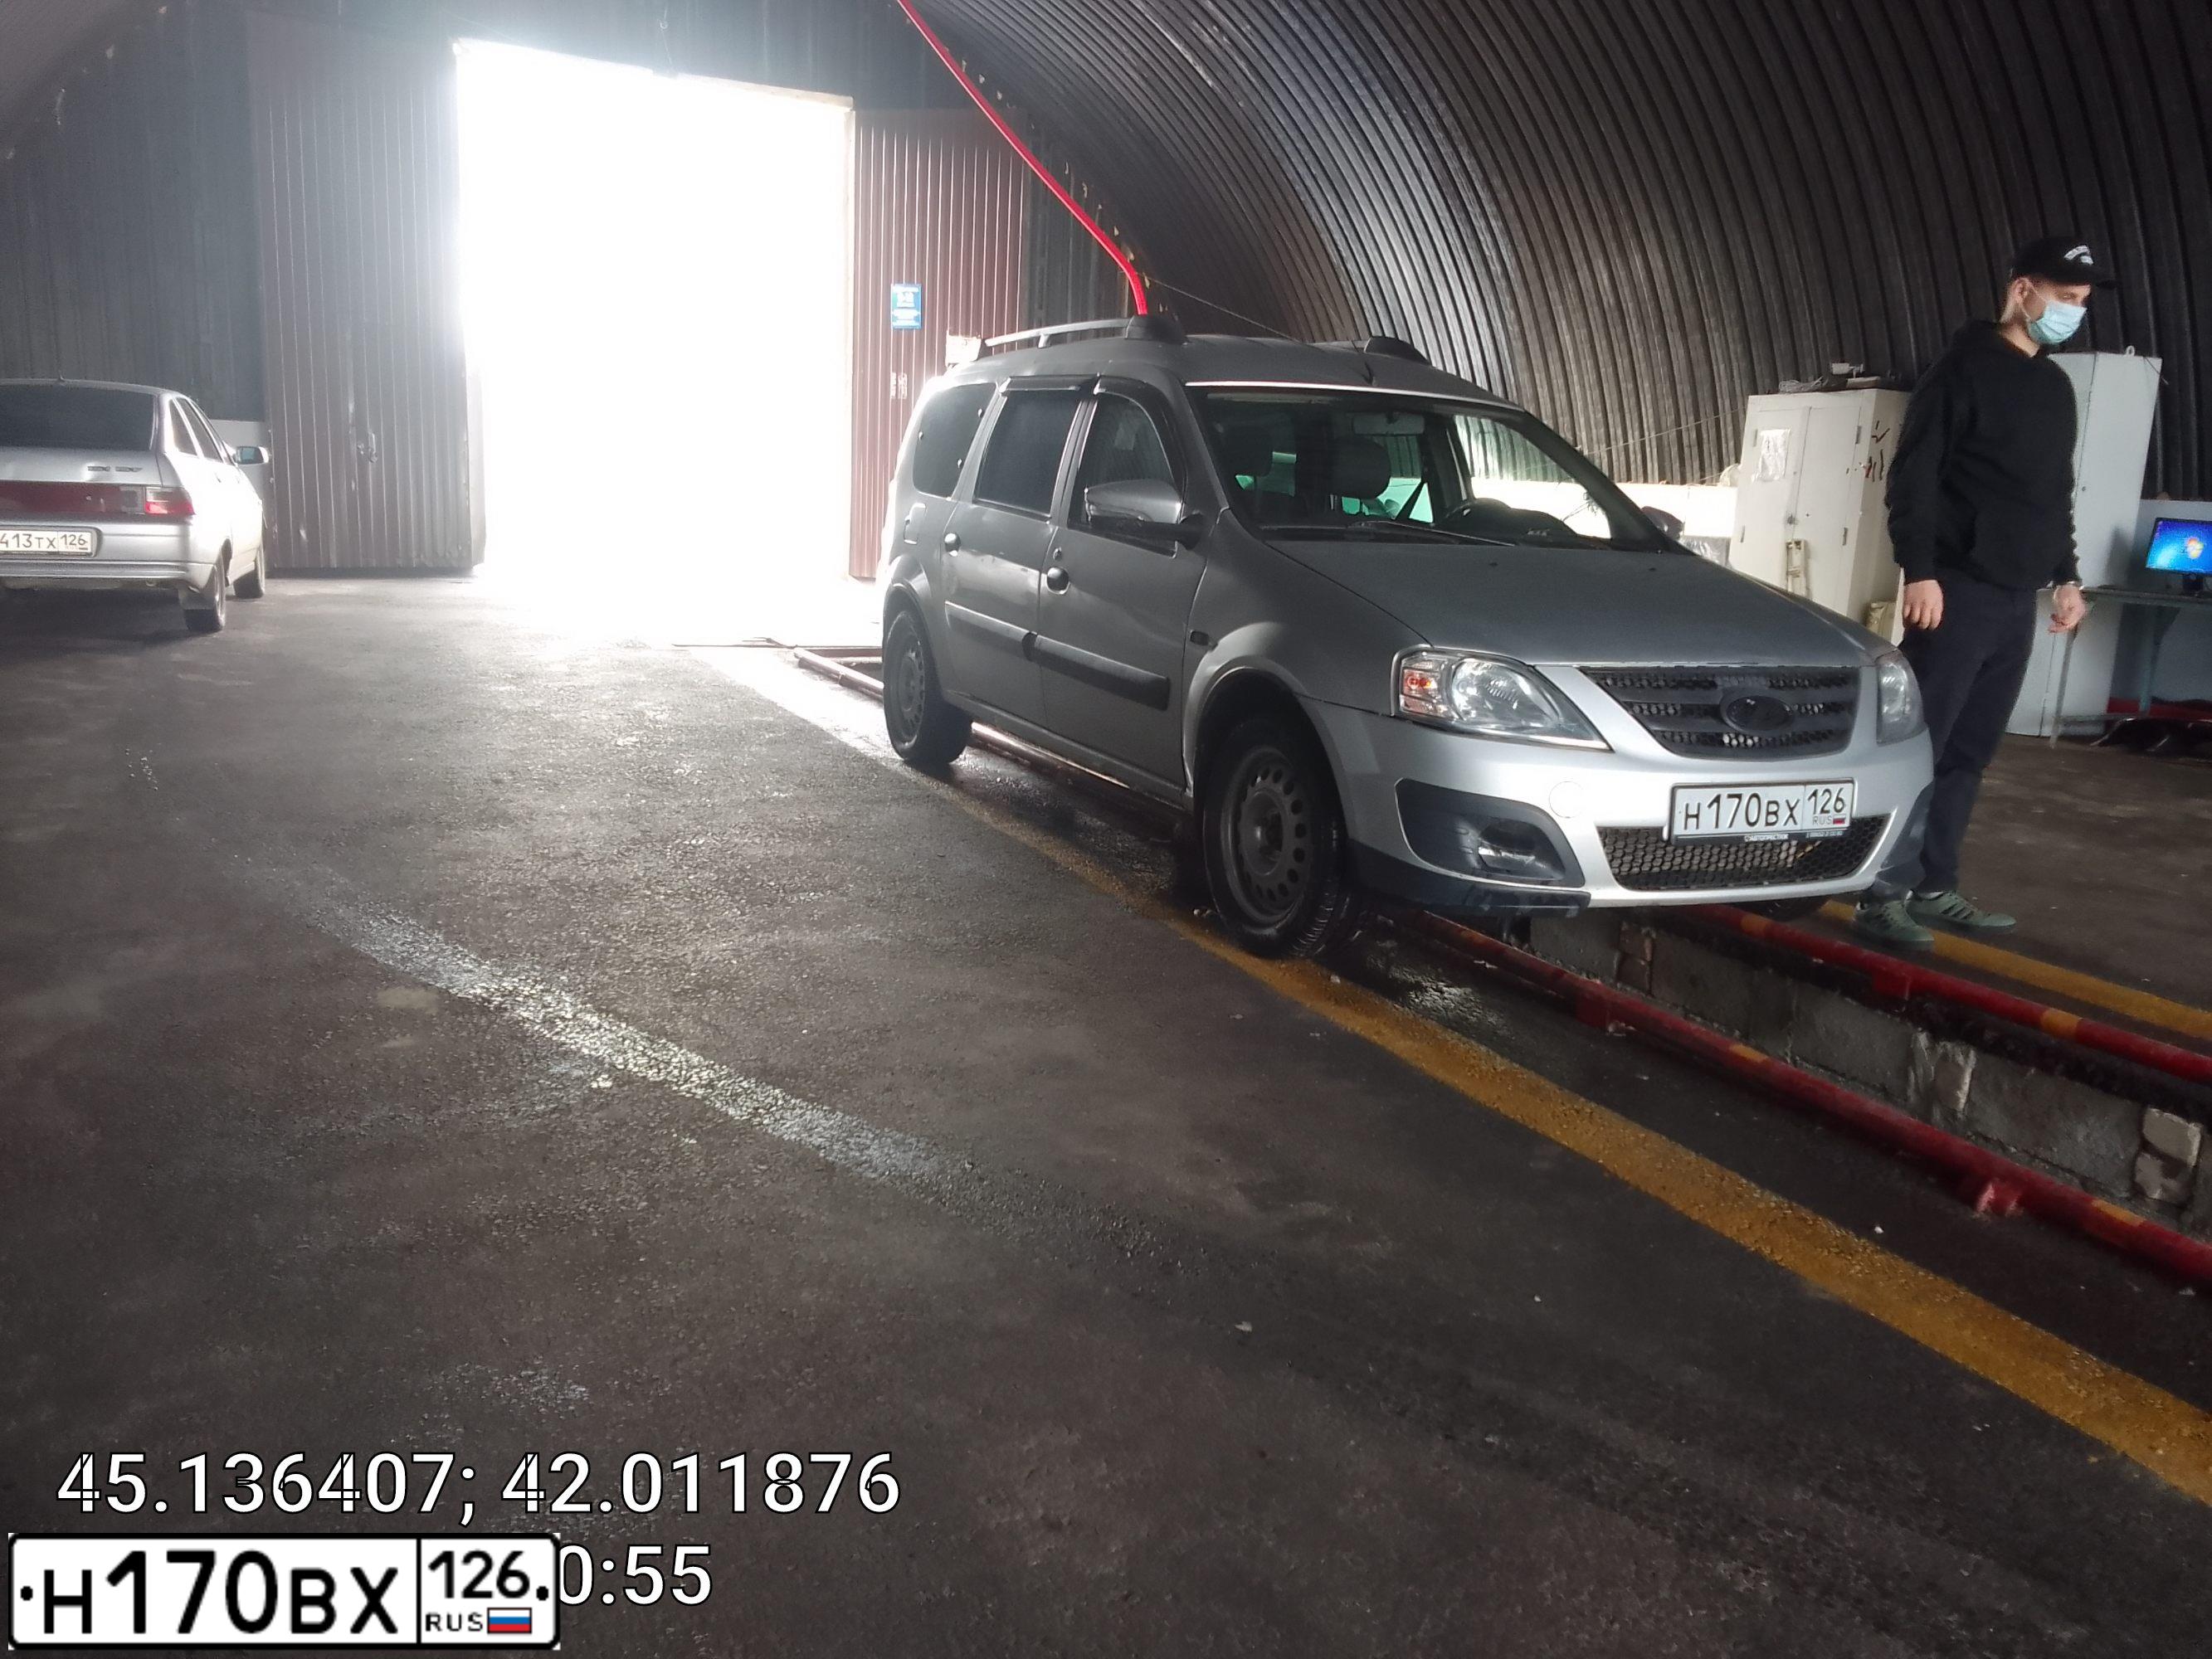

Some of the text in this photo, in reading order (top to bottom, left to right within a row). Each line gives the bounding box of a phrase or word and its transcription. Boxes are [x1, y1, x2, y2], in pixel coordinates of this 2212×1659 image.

[61, 534, 86, 546] 126
[1684, 787, 1845, 830] Н170ВХ 126
[1813, 815, 1833, 825] RUS
